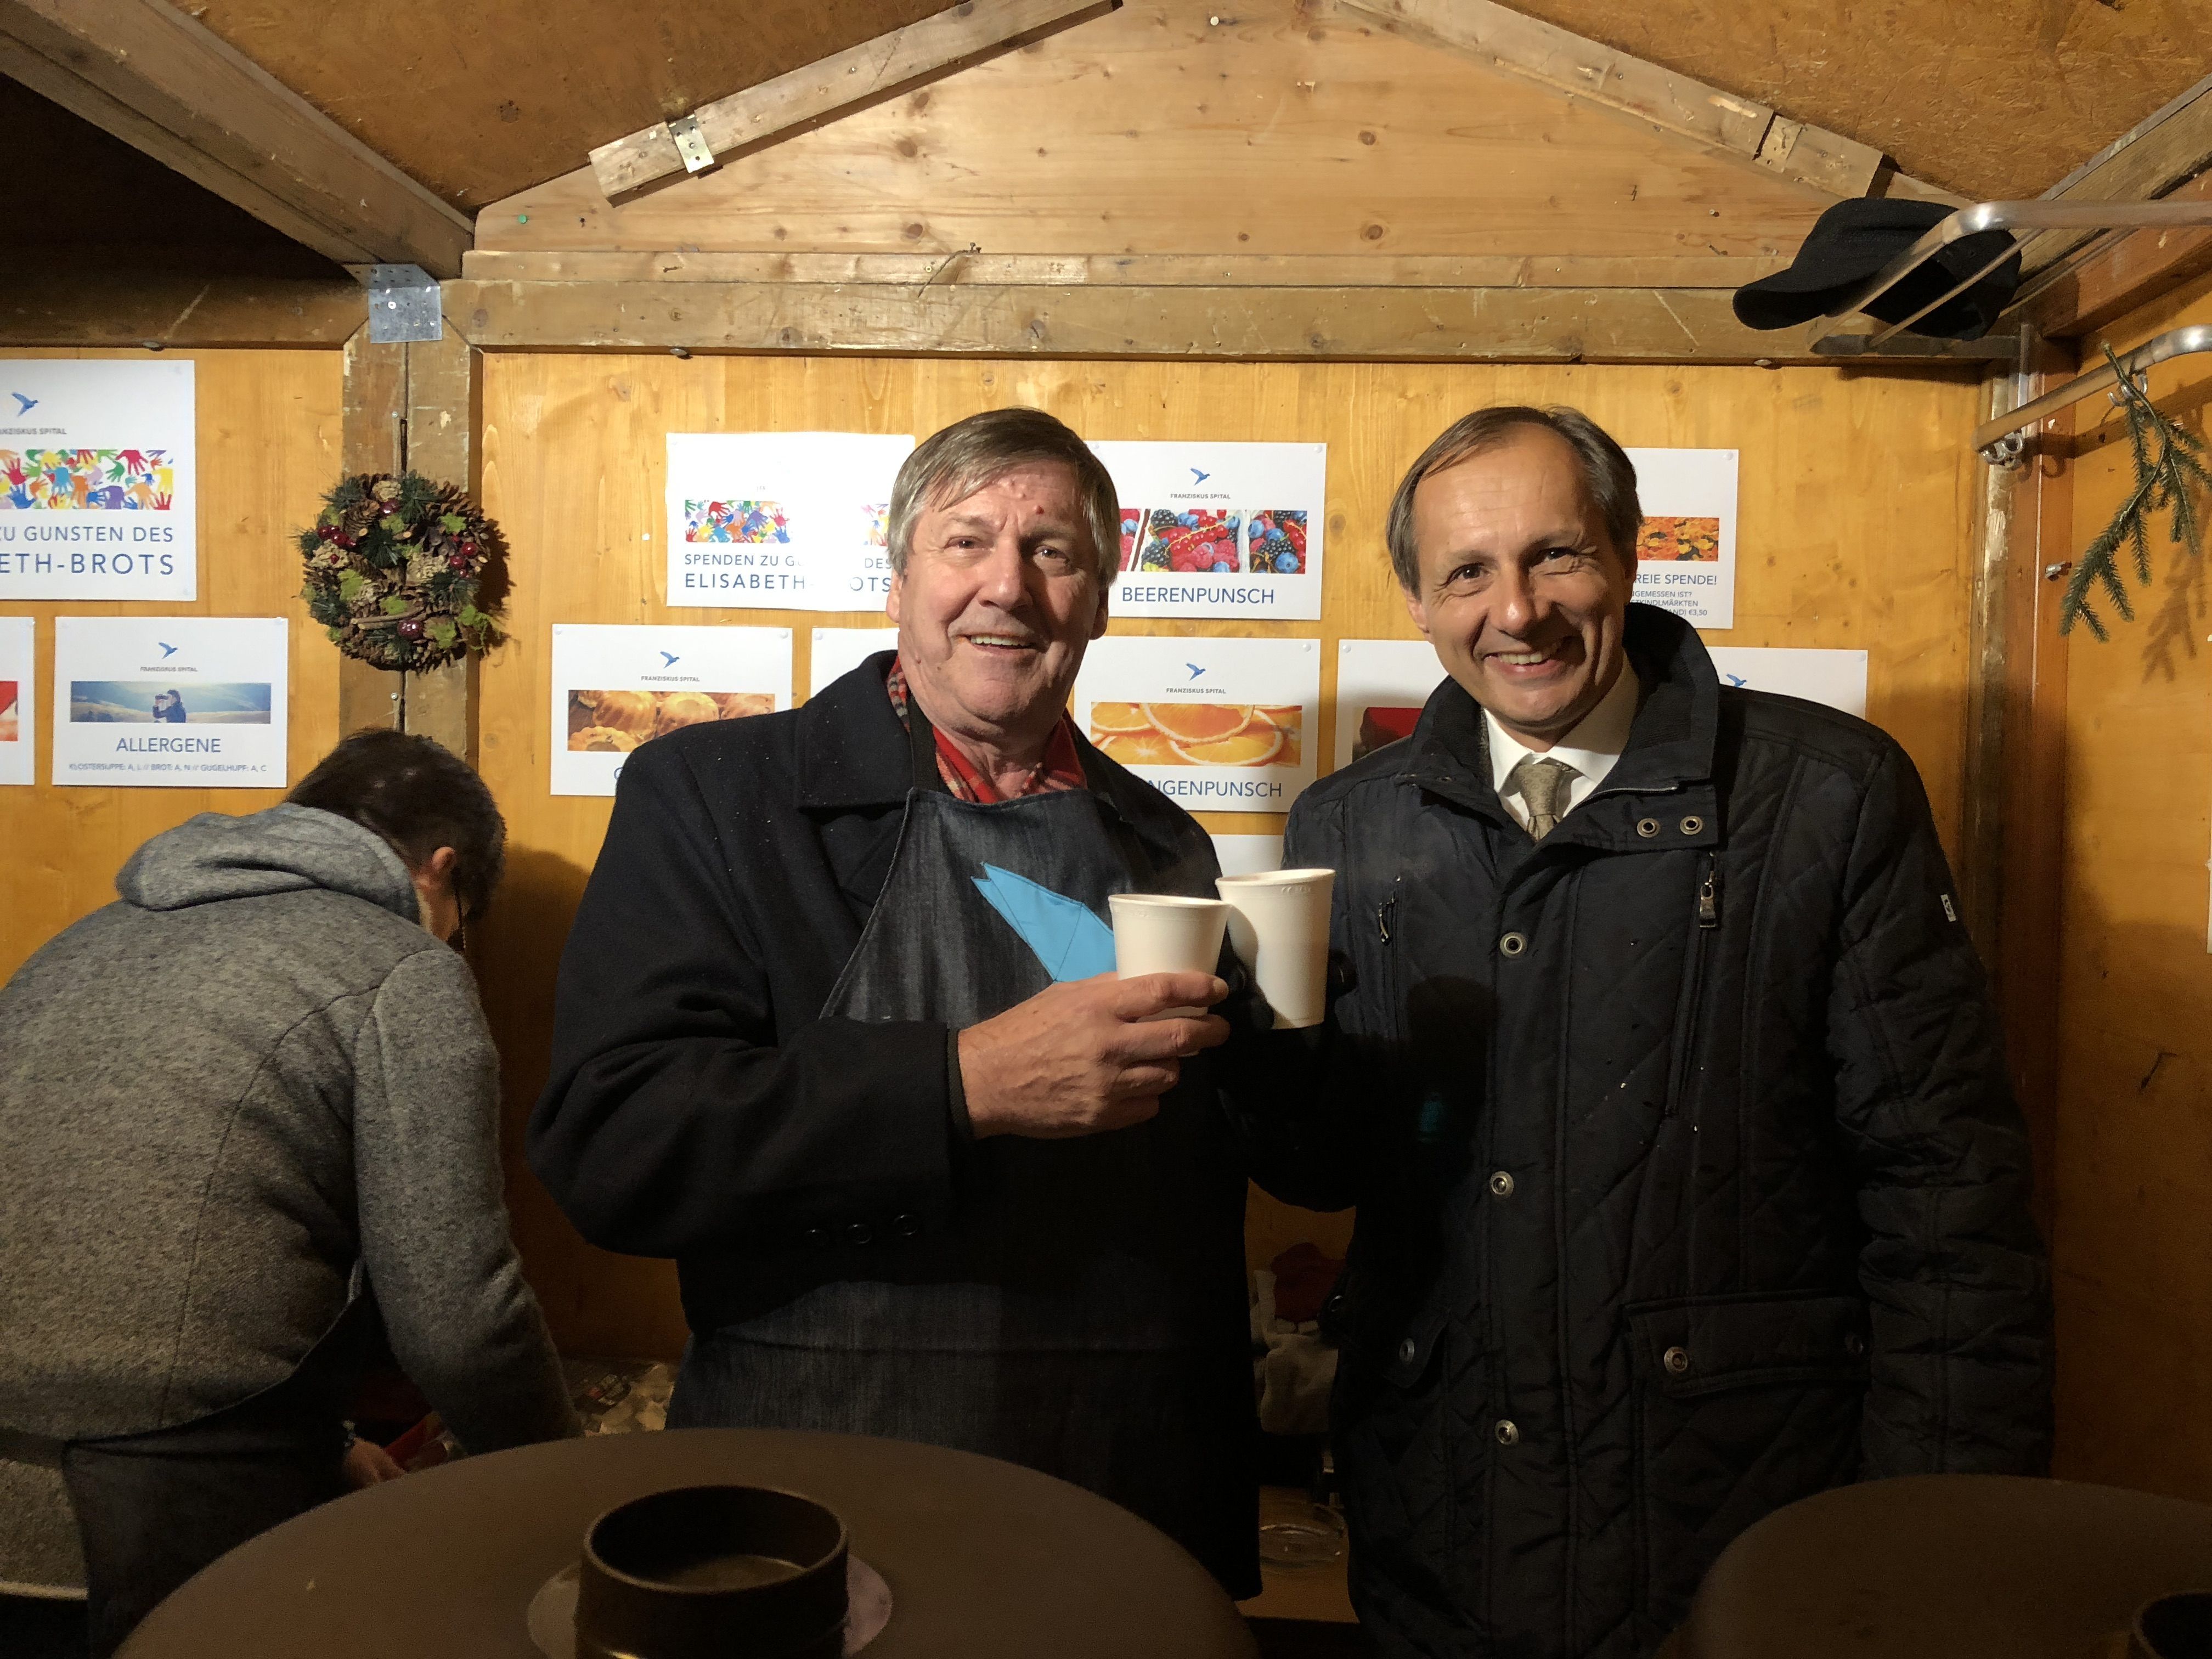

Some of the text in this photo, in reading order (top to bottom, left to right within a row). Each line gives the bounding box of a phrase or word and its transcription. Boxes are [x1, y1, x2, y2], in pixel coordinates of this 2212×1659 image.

[24, 526, 123, 541] GUNSTEN
[133, 527, 173, 542] DES
[0, 553, 174, 575] ETH-BROTS
[685, 554, 754, 566] SPENDEN
[760, 555, 778, 566] ZU
[1664, 574, 1717, 585] SPENDE!
[1122, 587, 1274, 604] BEERENPUNSCH
[116, 737, 221, 753] ALLERGENE
